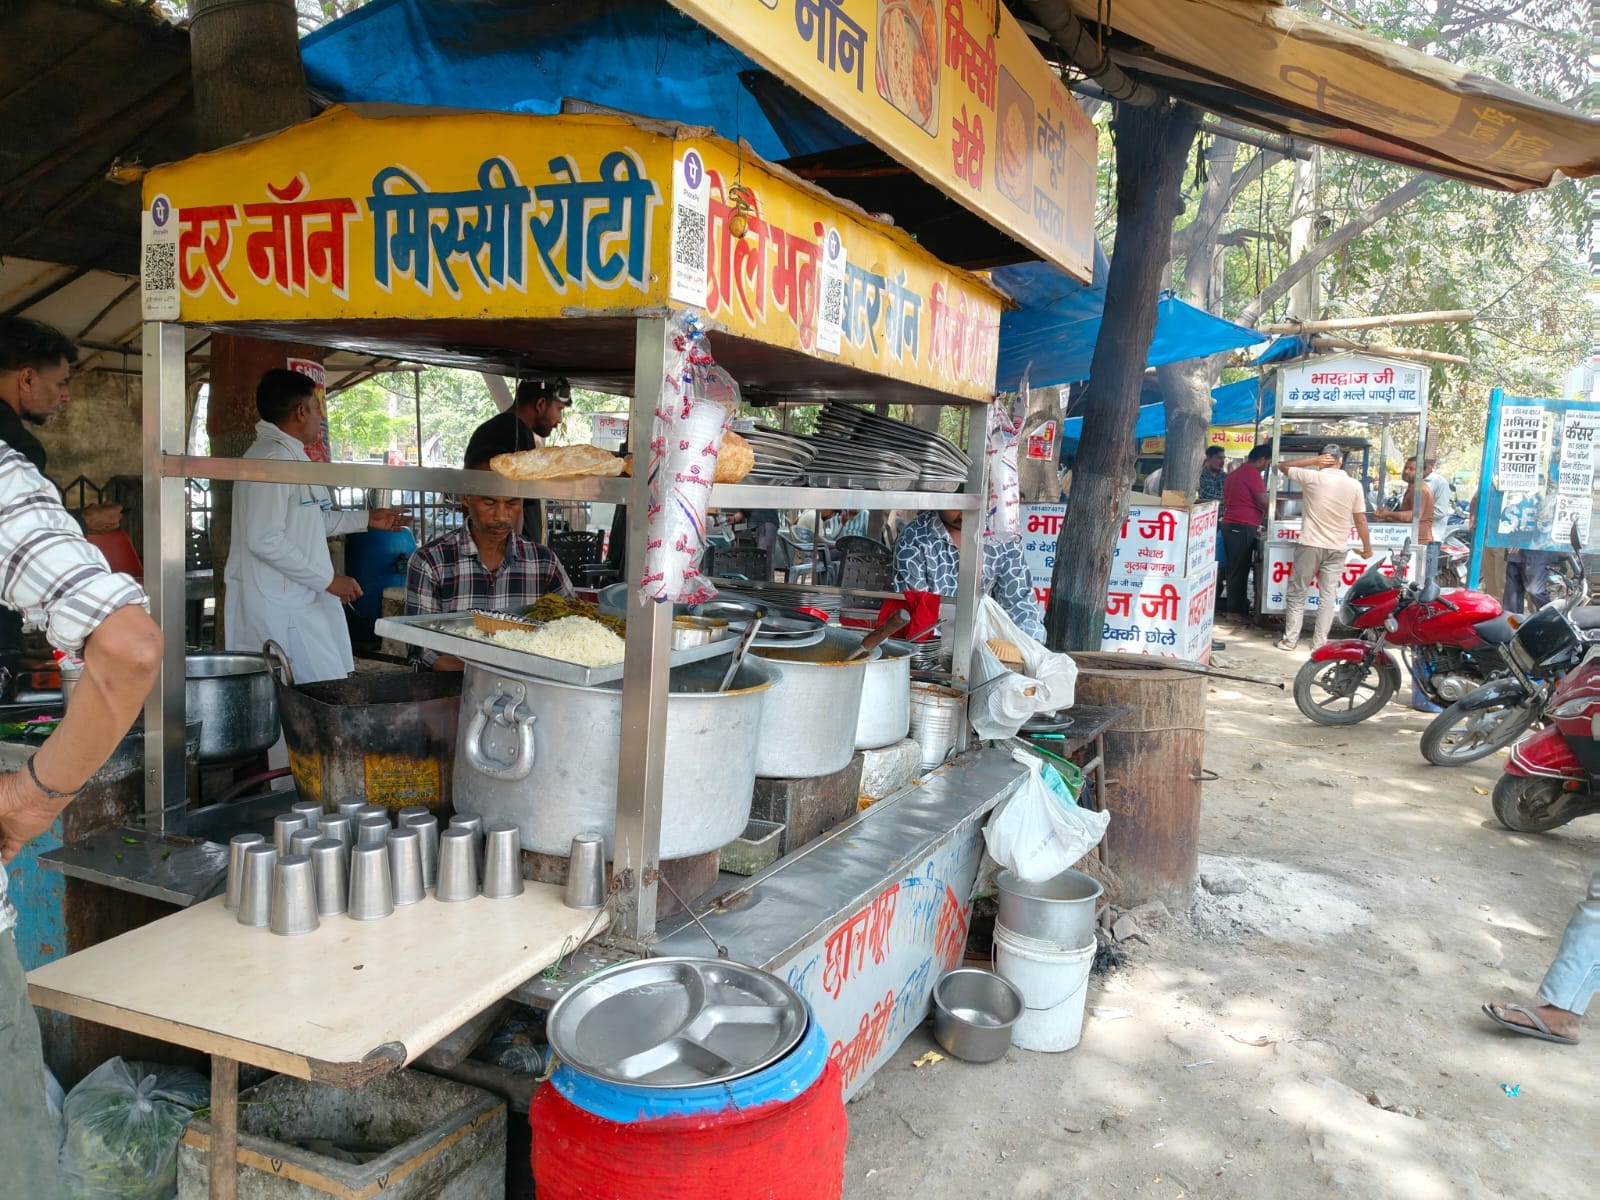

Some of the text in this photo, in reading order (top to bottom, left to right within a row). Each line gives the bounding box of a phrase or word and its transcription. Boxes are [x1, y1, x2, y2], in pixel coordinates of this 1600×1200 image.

[952, 104, 985, 192] रोटी
[179, 150, 657, 299] टर नॉन मिस्सी रोटी
[1311, 367, 1395, 385] भारद्वाज जी
[1289, 388, 1300, 400] के
[1323, 387, 1340, 401] दही
[1343, 387, 1365, 400] भल्ले
[1369, 387, 1396, 403] पापड़ी
[1503, 415, 1540, 427] अभिनव
[1503, 441, 1538, 449] नाक
[1502, 452, 1538, 462] गला
[1137, 511, 1178, 541] जी
[1026, 541, 1036, 551] के
[1137, 546, 1164, 558] स्पेशल
[1124, 561, 1147, 574] गुलाब
[1140, 584, 1181, 621] जी
[1145, 627, 1178, 645] छोले
